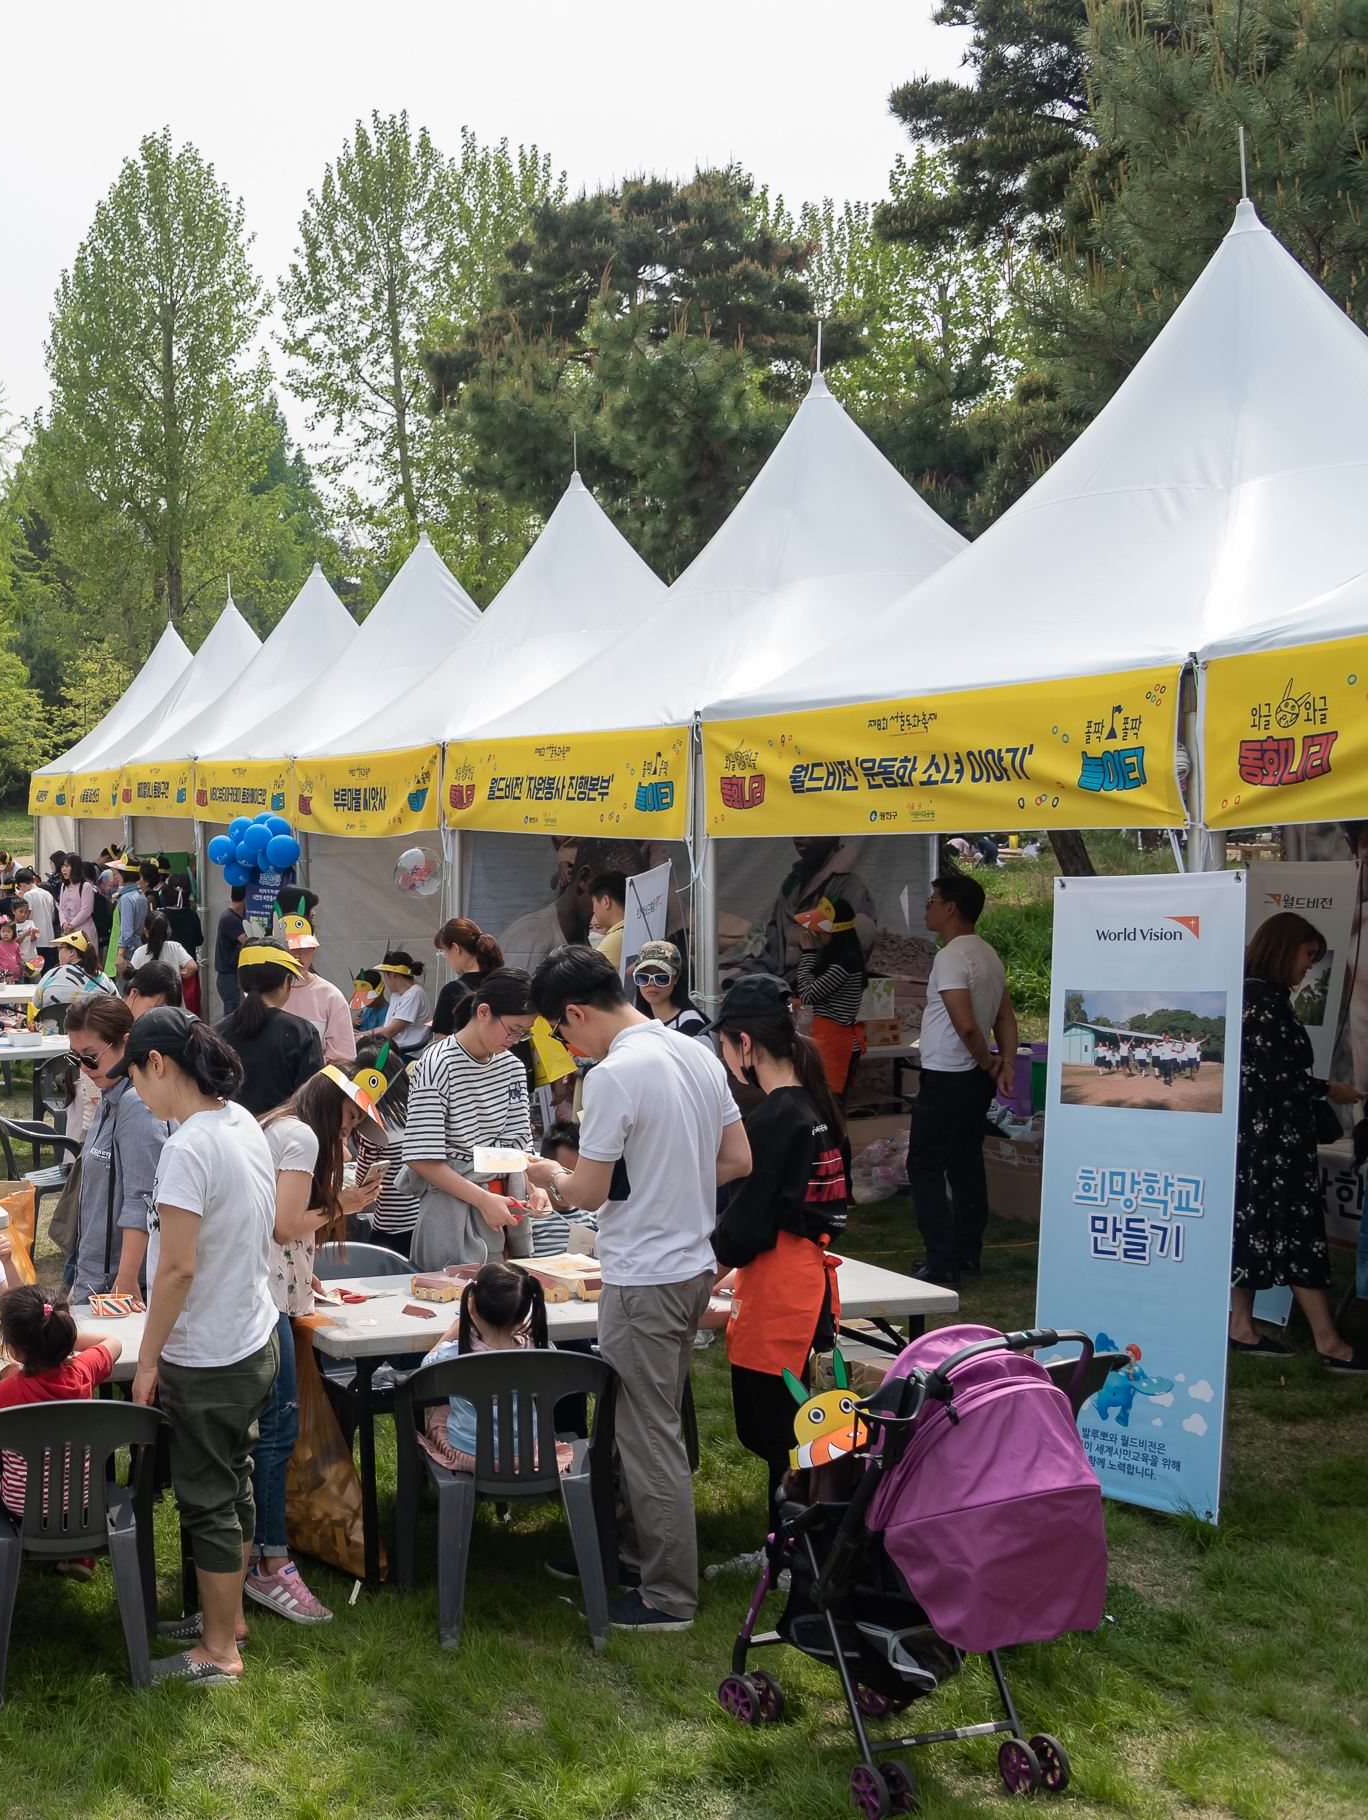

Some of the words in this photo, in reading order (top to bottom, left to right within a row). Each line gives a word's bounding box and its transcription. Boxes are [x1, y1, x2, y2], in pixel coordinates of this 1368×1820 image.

[867, 717, 888, 731] 제8회
[889, 711, 938, 734] 서울동화축제
[1250, 703, 1271, 731] 와글
[1304, 696, 1328, 725] 와글
[1085, 719, 1105, 744] 폴짝
[1122, 715, 1142, 741] 폴짝
[789, 760, 859, 794] 월드비전
[919, 751, 965, 787] 소녀
[1078, 745, 1147, 792] 놀이터
[1238, 731, 1338, 787] 동화나라
[333, 787, 361, 812] 부루마블
[362, 786, 387, 811] 씨앗사
[487, 776, 524, 801] 월드비전
[634, 781, 674, 812] 놀이터
[720, 774, 766, 810] 동화나라
[879, 811, 898, 821] 광진구
[1282, 894, 1333, 910] 월드비전
[1096, 927, 1137, 942] World
[1139, 927, 1183, 942] Vision
[1074, 1168, 1201, 1217] 희망학교
[1090, 1215, 1181, 1261] 만들기
[1094, 1443, 1159, 1467] 세계시민교육을
[1161, 1458, 1181, 1472] 위해
[1120, 1435, 1166, 1455] 월드비전은
[1107, 1460, 1157, 1480] 노력합니다.
